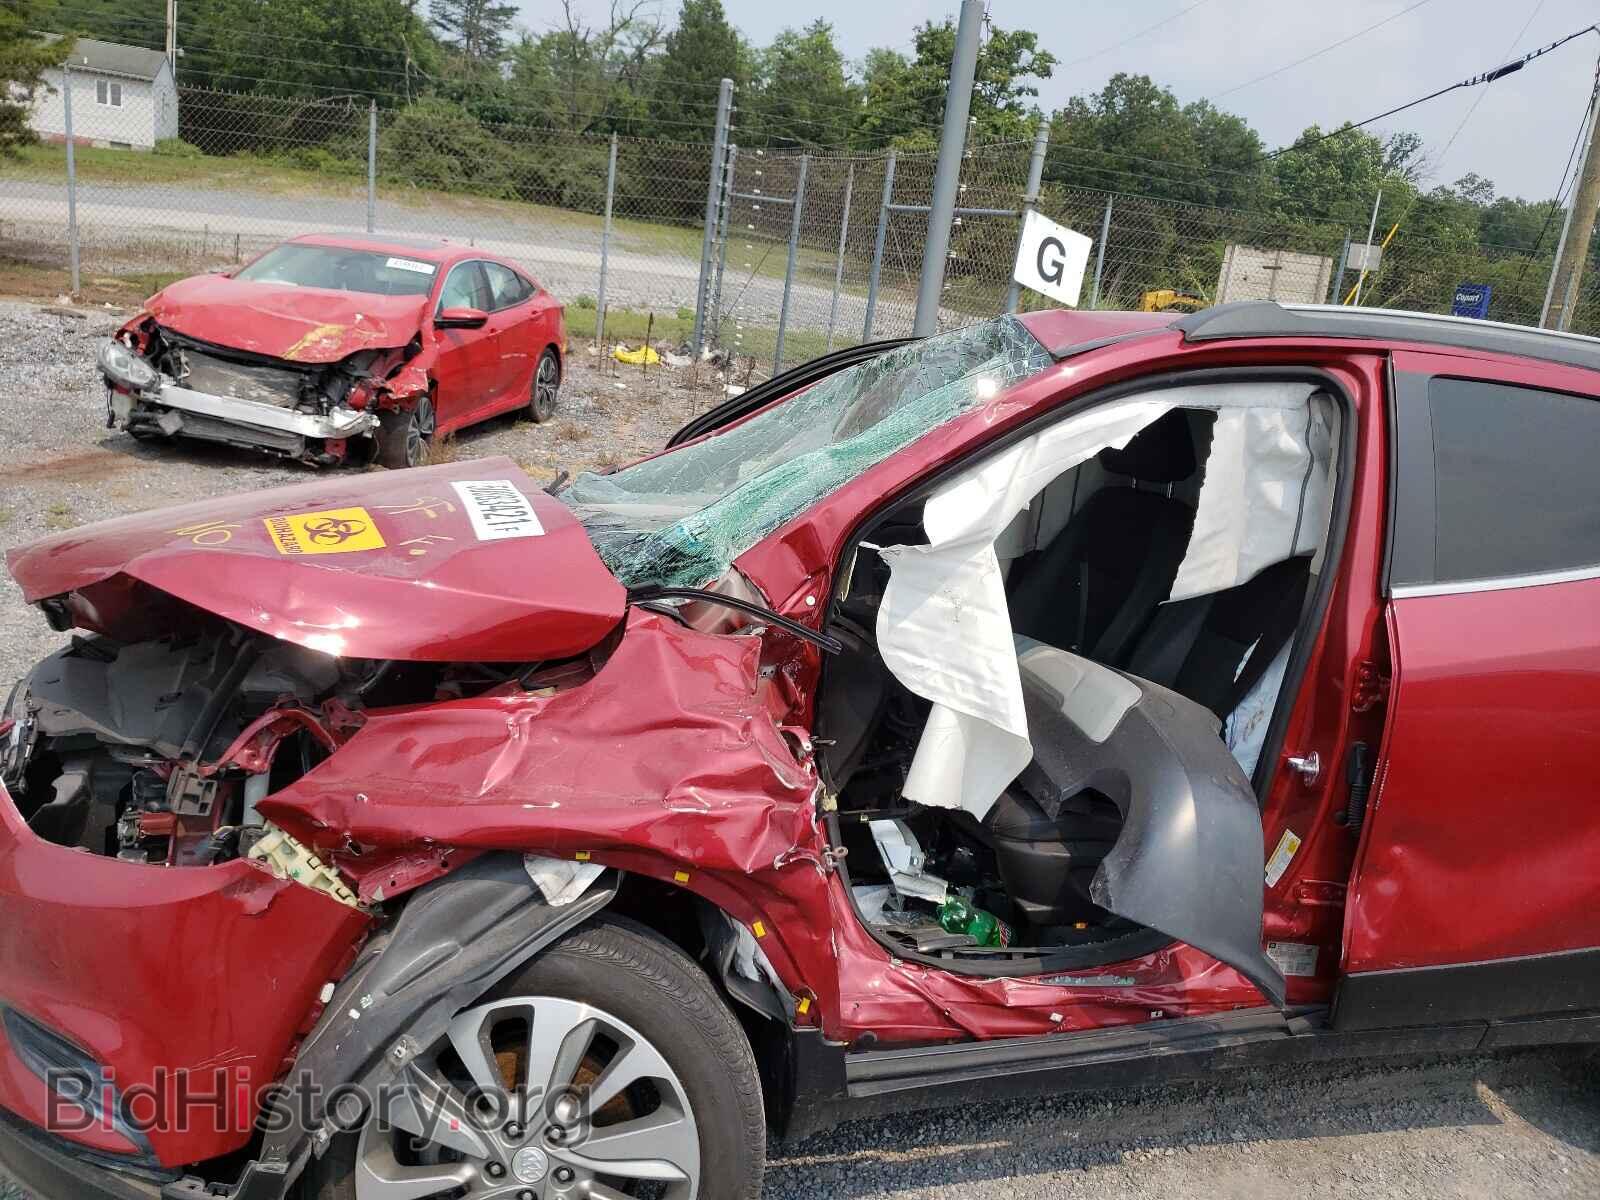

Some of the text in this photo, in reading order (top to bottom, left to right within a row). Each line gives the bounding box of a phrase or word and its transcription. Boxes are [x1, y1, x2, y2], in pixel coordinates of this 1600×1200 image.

[1037, 236, 1066, 287] G
[1456, 292, 1480, 302] Copart
[269, 517, 304, 553] BIOHAZARD
